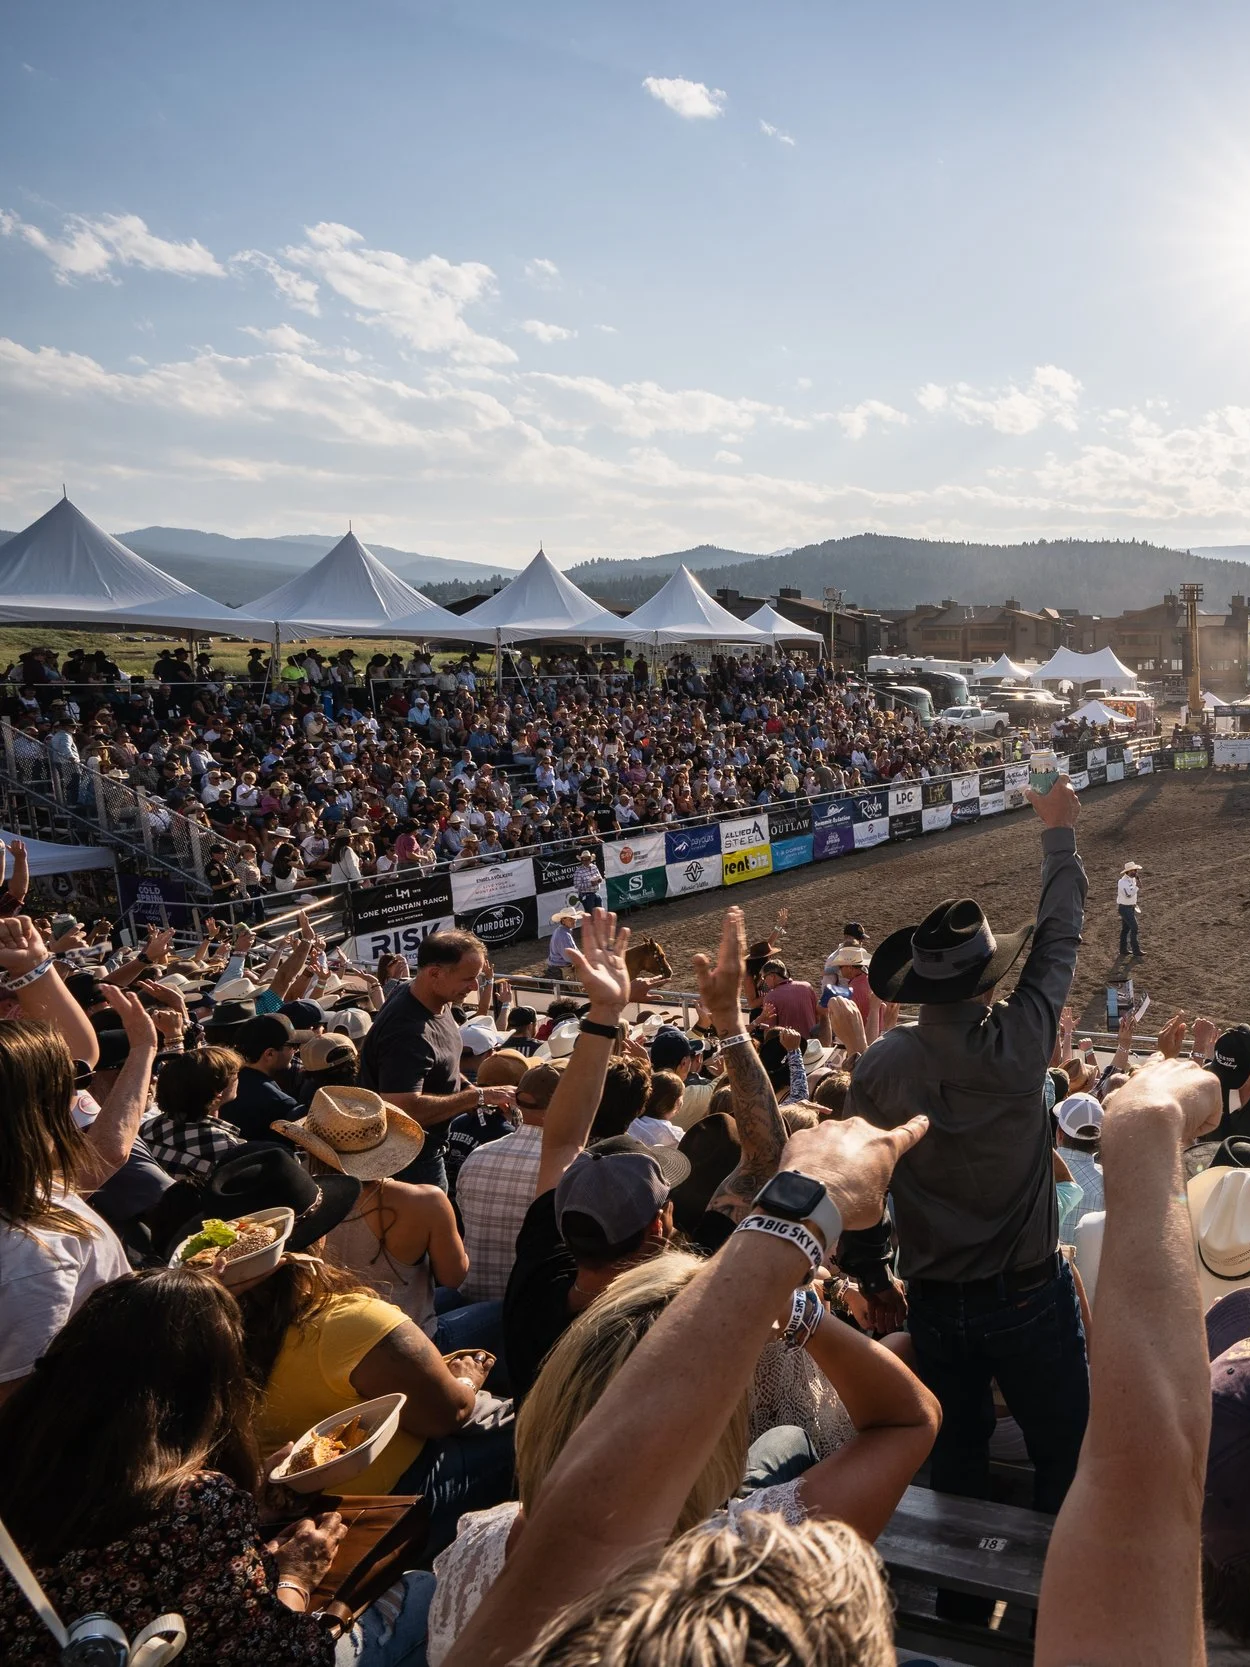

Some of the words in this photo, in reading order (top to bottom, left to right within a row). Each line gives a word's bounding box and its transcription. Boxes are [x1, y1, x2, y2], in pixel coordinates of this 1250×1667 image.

[896, 792, 913, 805] LPC
[961, 803, 978, 814] pepsi
[771, 819, 810, 835] OUTLAW
[815, 819, 831, 827] Summit
[725, 828, 752, 839] ALLIED
[725, 835, 761, 848] STEEL
[542, 870, 559, 880] LONE
[561, 866, 580, 874] MOUN
[358, 910, 379, 920] LONE
[381, 901, 421, 915] MOUNTAIN
[423, 895, 449, 905] RANCH
[476, 916, 521, 933] MURDOCH'S
[763, 1219, 788, 1234] BIG
[789, 1226, 815, 1249] SKY
[789, 1315, 800, 1330] BIG
[795, 1298, 804, 1313] SKY
[983, 1539, 998, 1549] 18
